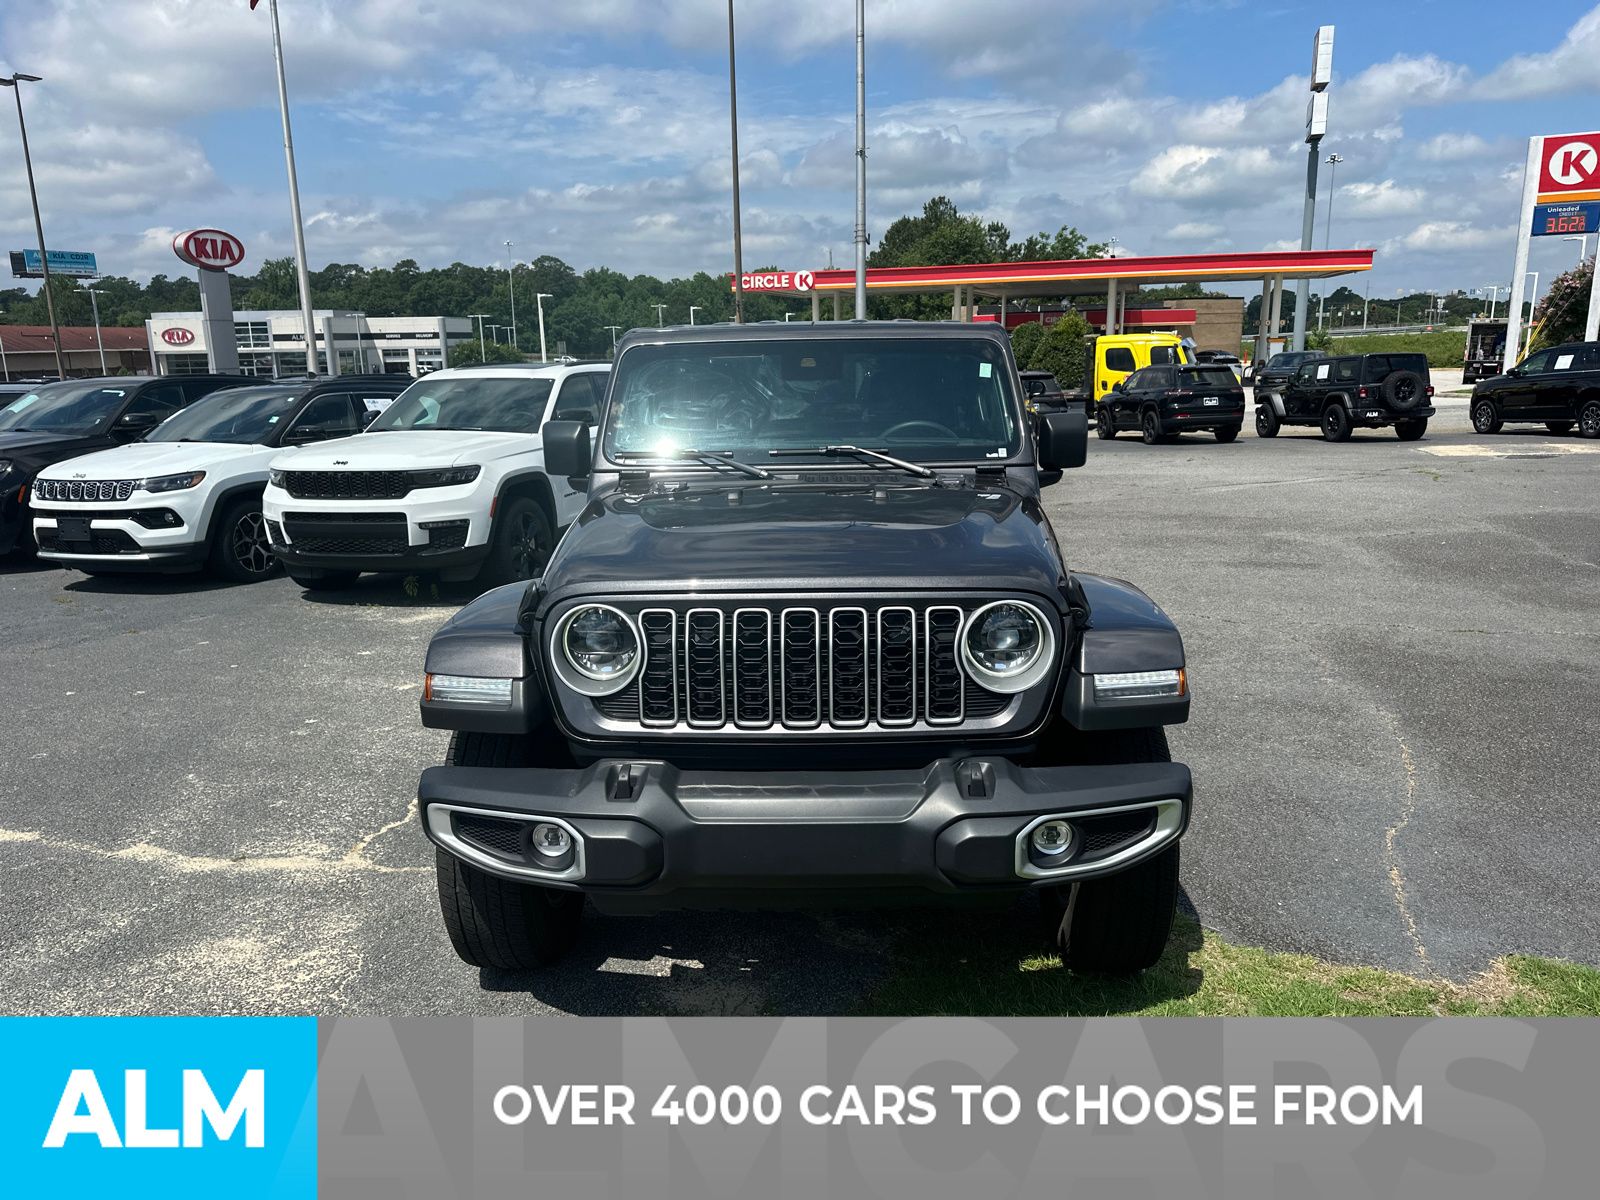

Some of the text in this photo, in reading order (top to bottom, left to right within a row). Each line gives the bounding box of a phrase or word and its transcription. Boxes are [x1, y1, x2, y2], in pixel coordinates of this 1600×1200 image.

[193, 237, 237, 261] KIA
[741, 274, 790, 290] CIRCLE
[166, 330, 190, 343] KIA
